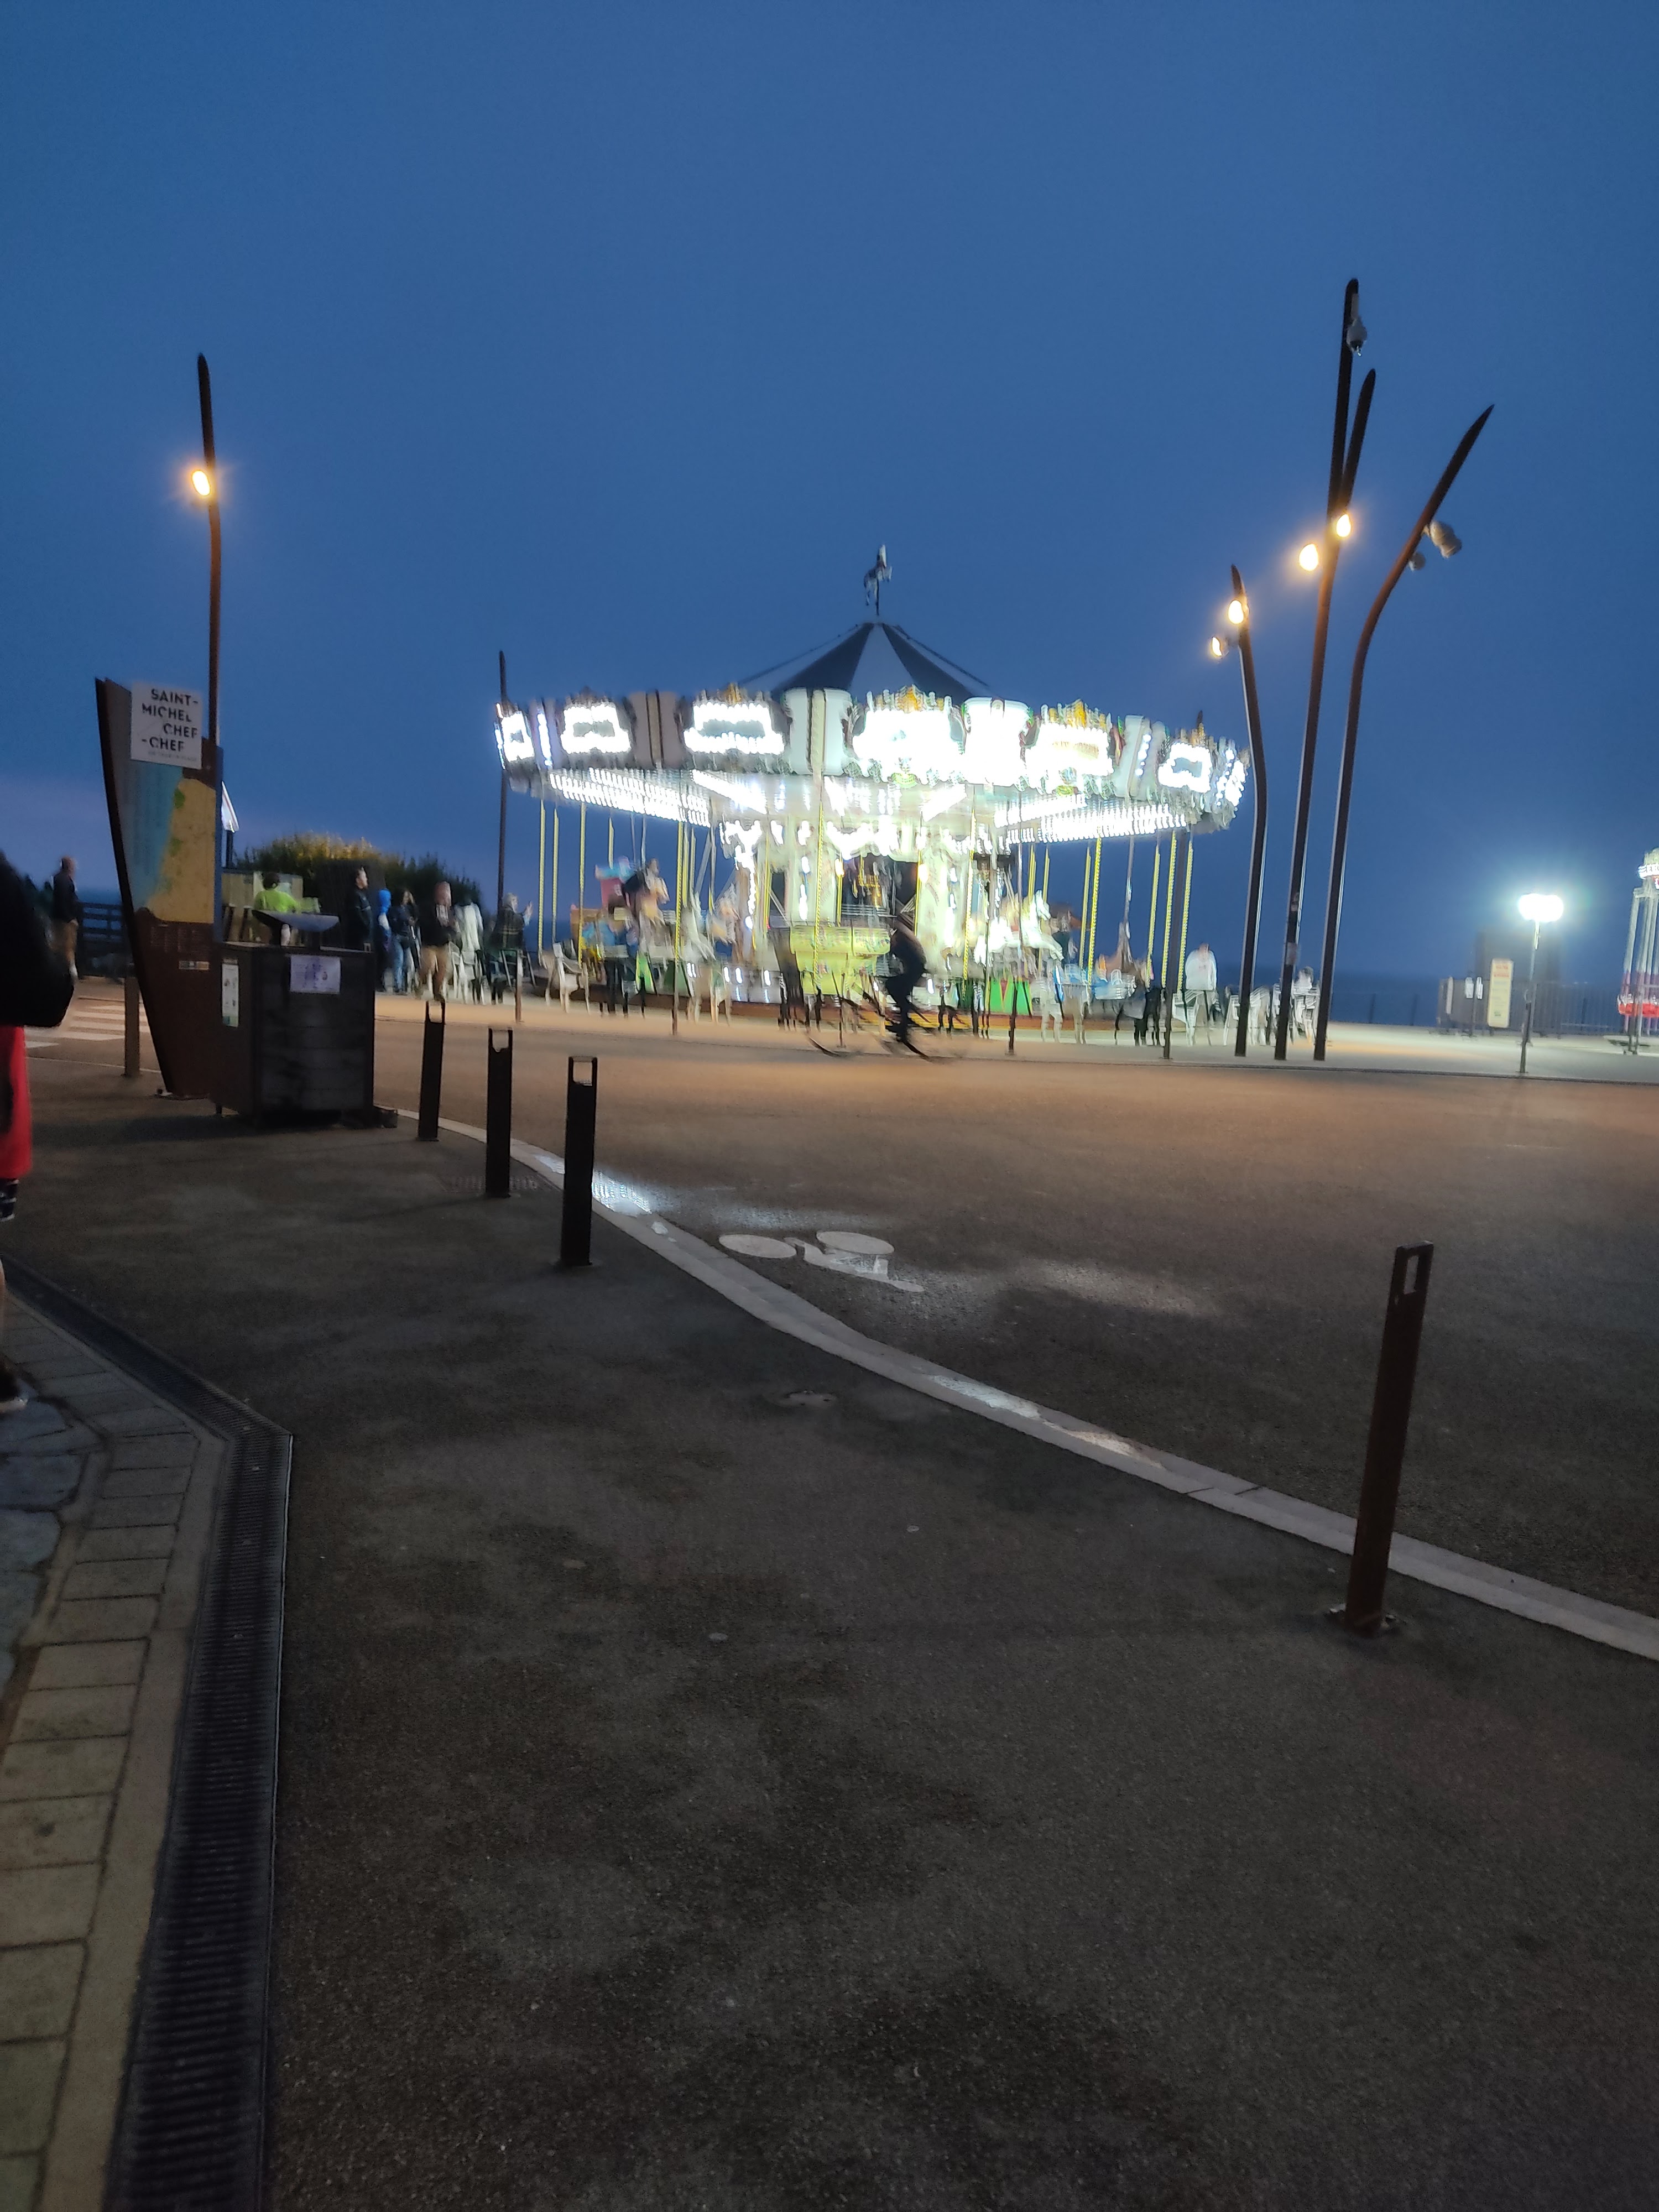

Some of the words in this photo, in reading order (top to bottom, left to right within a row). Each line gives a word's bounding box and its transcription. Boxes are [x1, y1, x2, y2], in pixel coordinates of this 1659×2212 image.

[151, 688, 199, 706] SAINT-
[142, 703, 192, 722] MICHEL
[163, 723, 198, 738] CHEF
[142, 736, 185, 752] -CHEF
